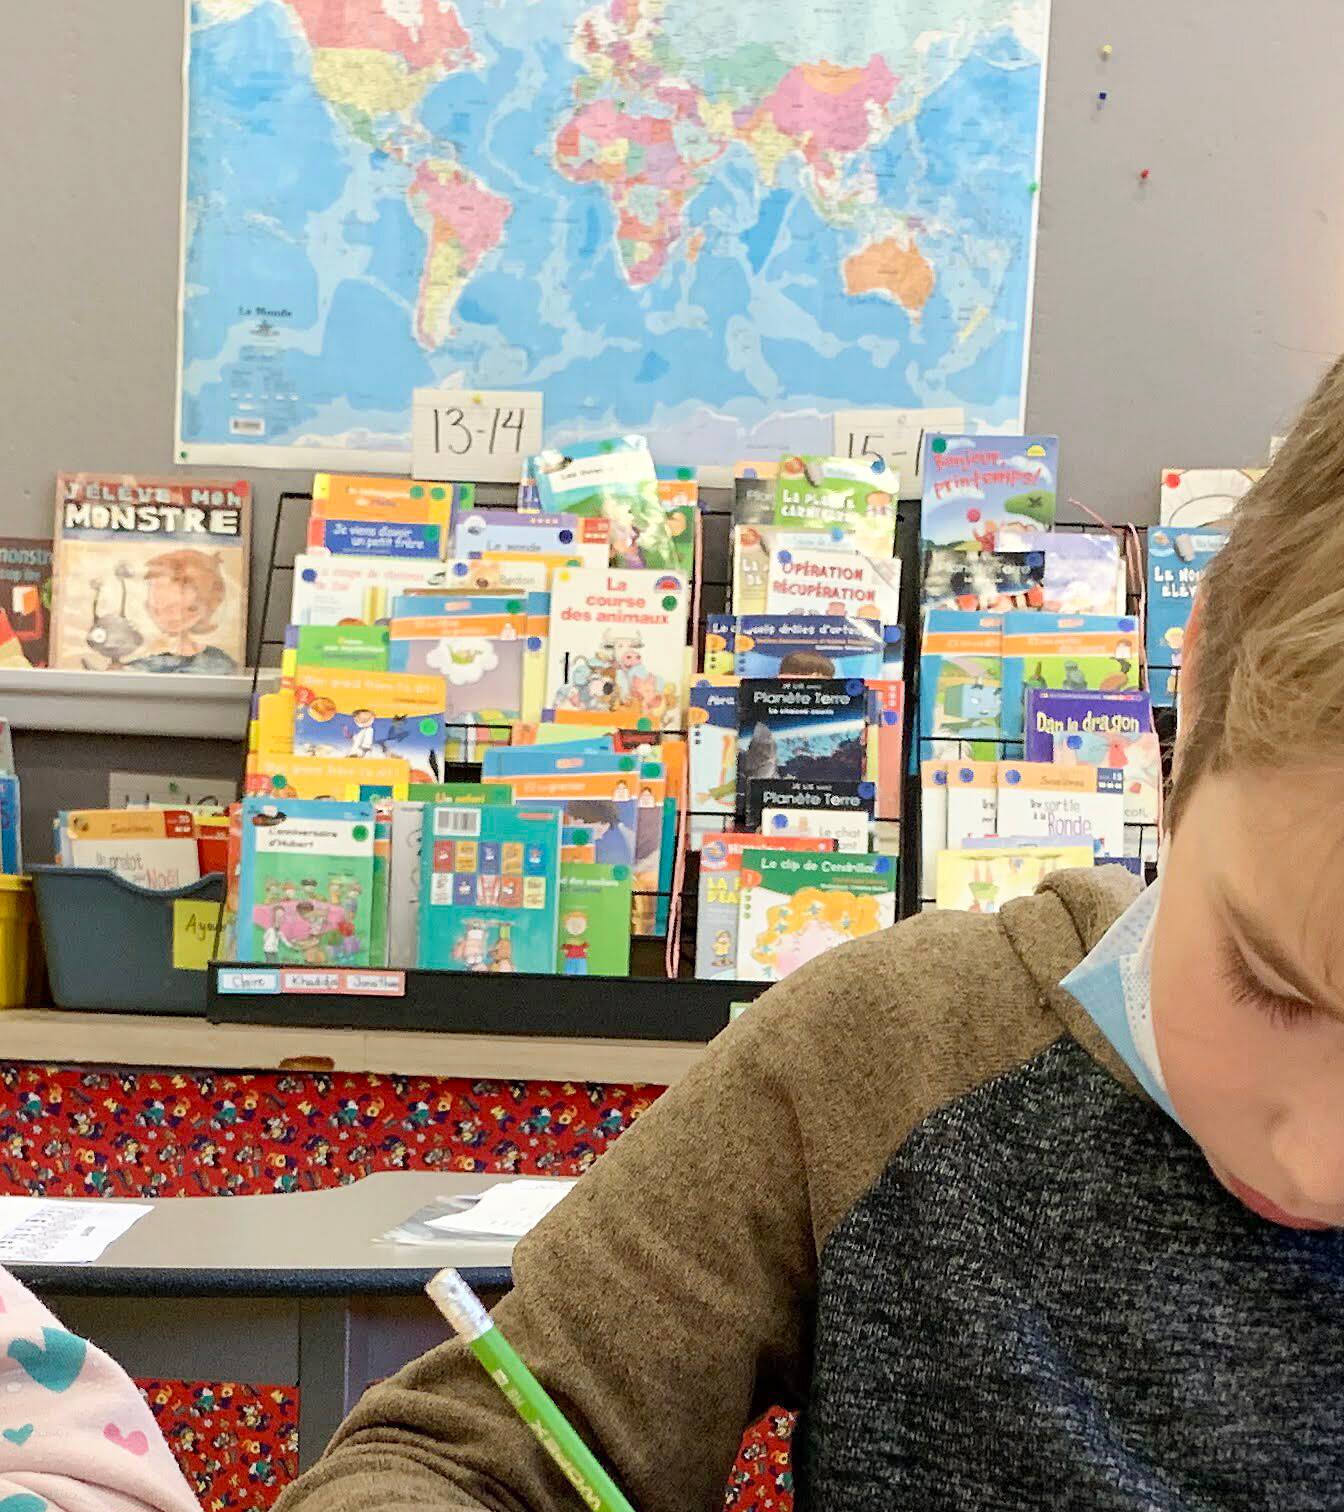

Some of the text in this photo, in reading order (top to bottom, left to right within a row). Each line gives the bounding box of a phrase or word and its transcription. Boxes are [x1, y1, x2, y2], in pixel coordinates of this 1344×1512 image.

[431, 408, 526, 456] 13-14
[191, 487, 242, 508] MON
[65, 502, 240, 536] MONSTRE
[607, 577, 628, 592] La
[585, 594, 647, 609] course
[560, 607, 670, 626] des animaux
[814, 691, 851, 707] Terre
[1035, 711, 1065, 734] Dan
[1082, 710, 1140, 734] dragon
[824, 792, 862, 807] Terre
[1047, 815, 1092, 836] Ronde
[802, 859, 818, 872] de
